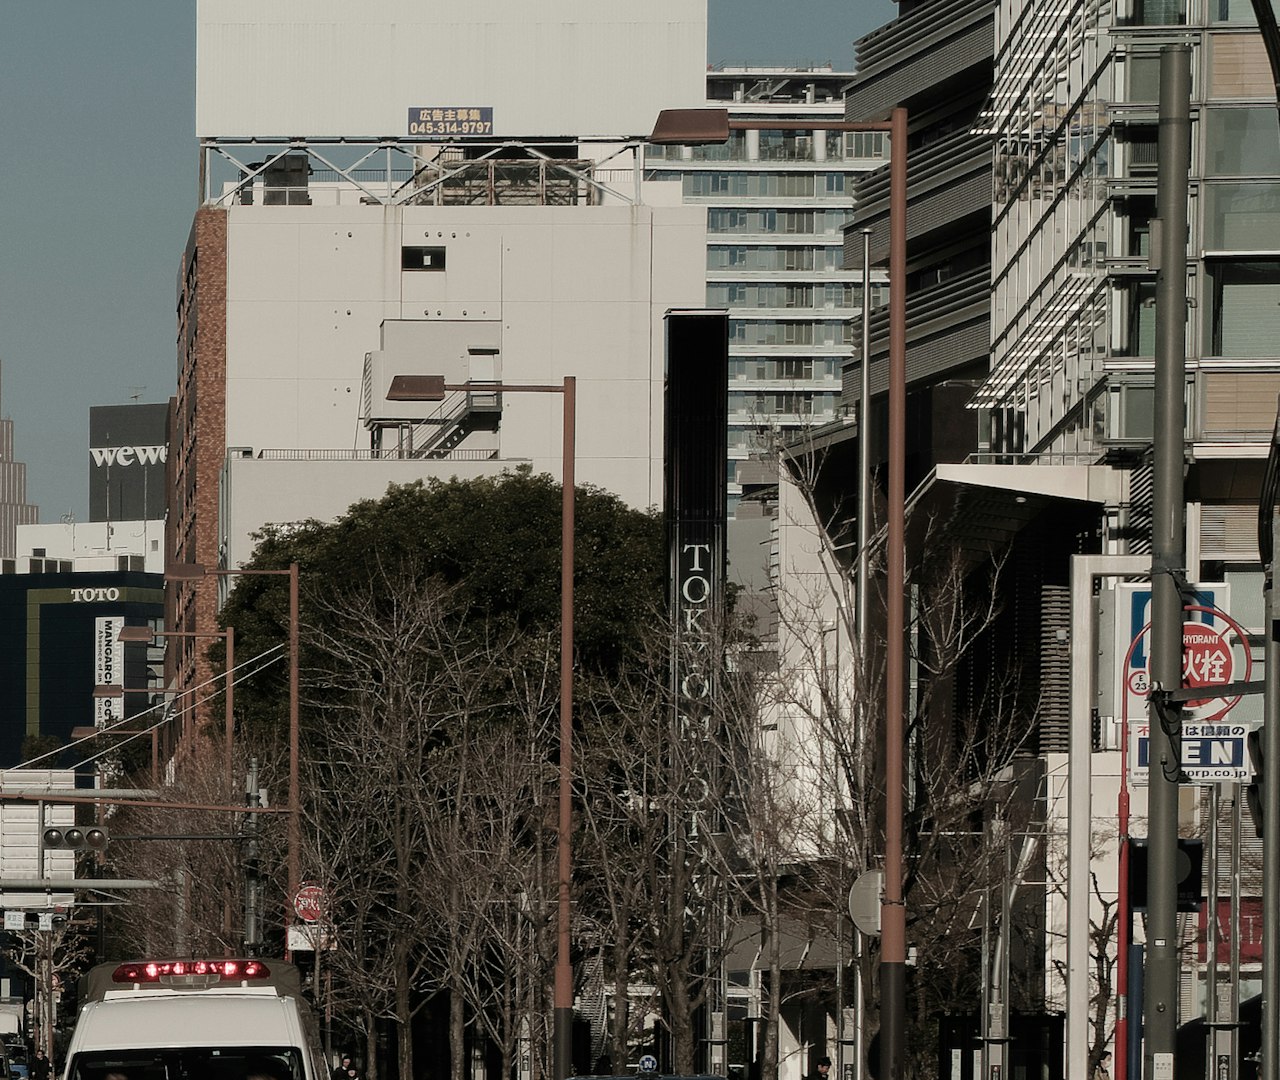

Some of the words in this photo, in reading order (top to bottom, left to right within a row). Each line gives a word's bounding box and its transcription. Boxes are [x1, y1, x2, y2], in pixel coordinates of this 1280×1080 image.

[419, 109, 481, 121] 広告主募集
[409, 121, 492, 134] 045-314-9797
[70, 587, 120, 603] TOTO
[681, 543, 711, 700] TOKYO
[1182, 634, 1220, 645] HYDRANT
[1182, 649, 1227, 682] 火栓
[1137, 725, 1246, 737] 不は信頼の
